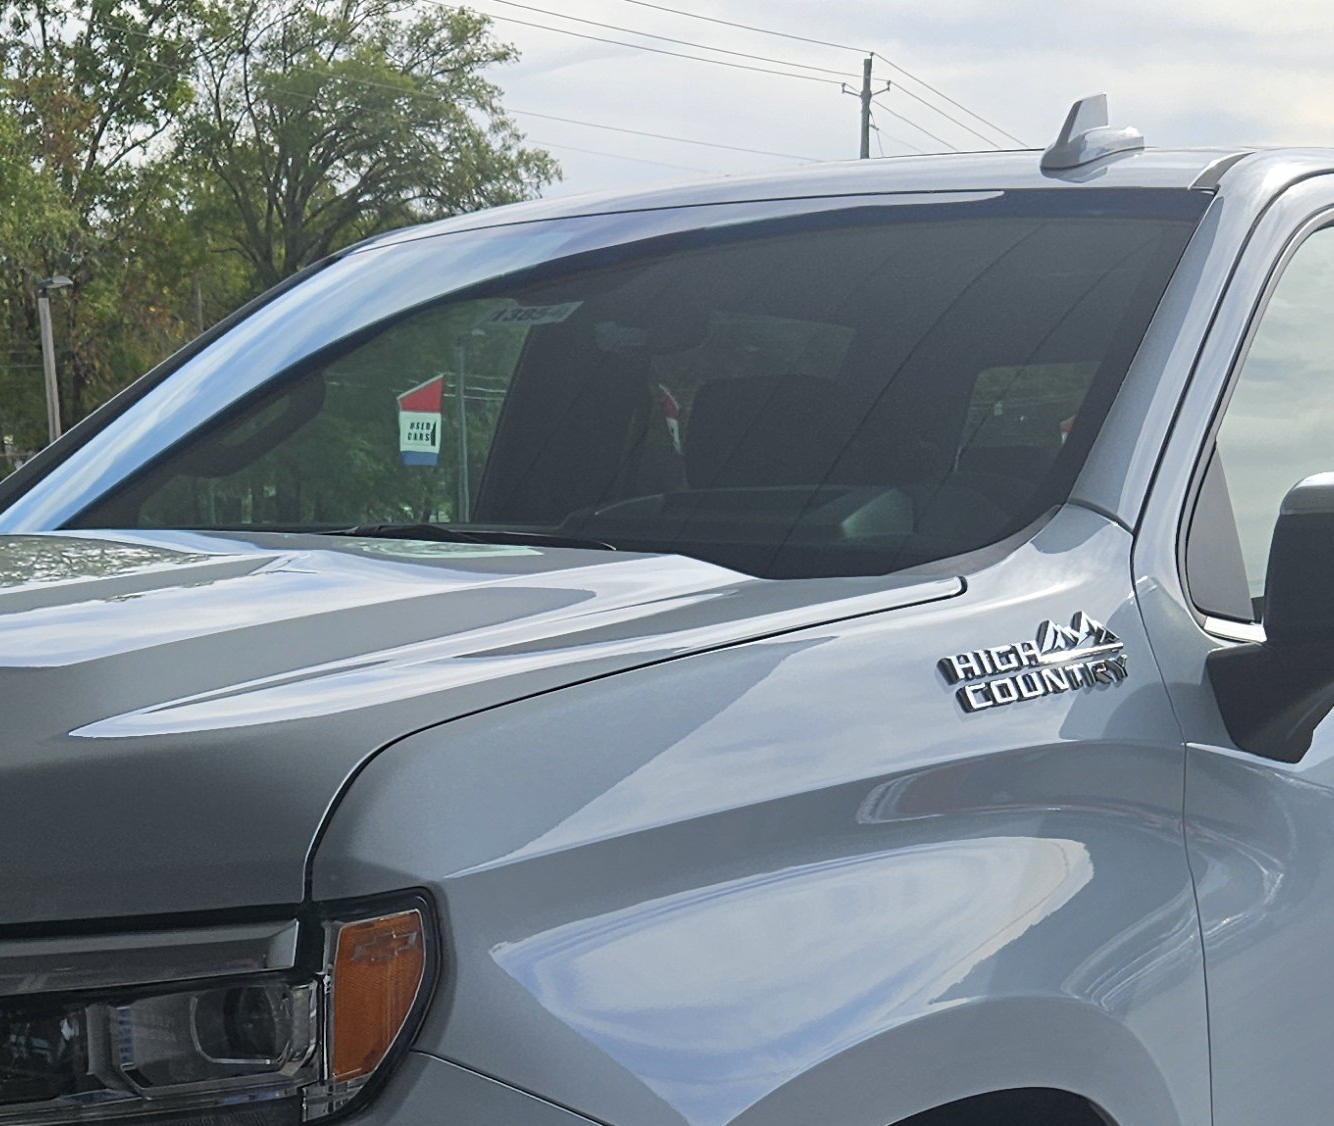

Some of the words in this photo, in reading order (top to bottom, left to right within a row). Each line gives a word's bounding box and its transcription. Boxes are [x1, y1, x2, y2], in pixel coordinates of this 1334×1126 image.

[408, 432, 430, 441] CARS
[409, 422, 431, 430] USED
[937, 640, 1041, 685] HIGH
[956, 654, 1129, 713] COUNTRY
